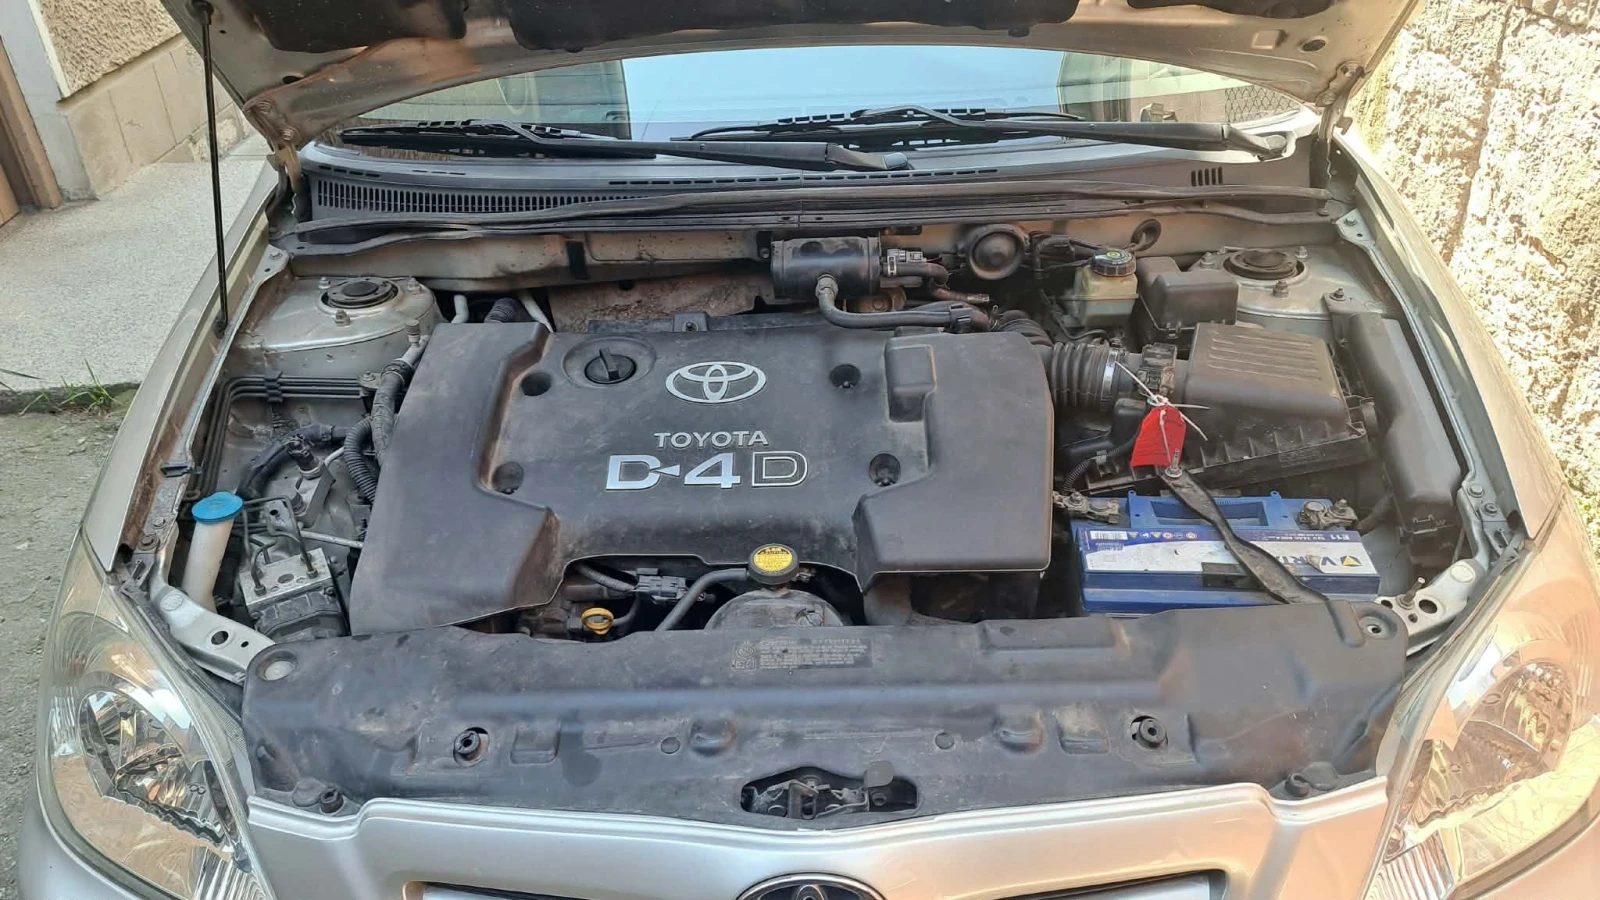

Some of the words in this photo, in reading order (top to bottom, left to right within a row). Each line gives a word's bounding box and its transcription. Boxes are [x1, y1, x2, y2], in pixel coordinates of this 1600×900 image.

[654, 430, 768, 449] TOYOTA
[606, 451, 808, 490] D-4D
[1275, 556, 1337, 566] VRT
